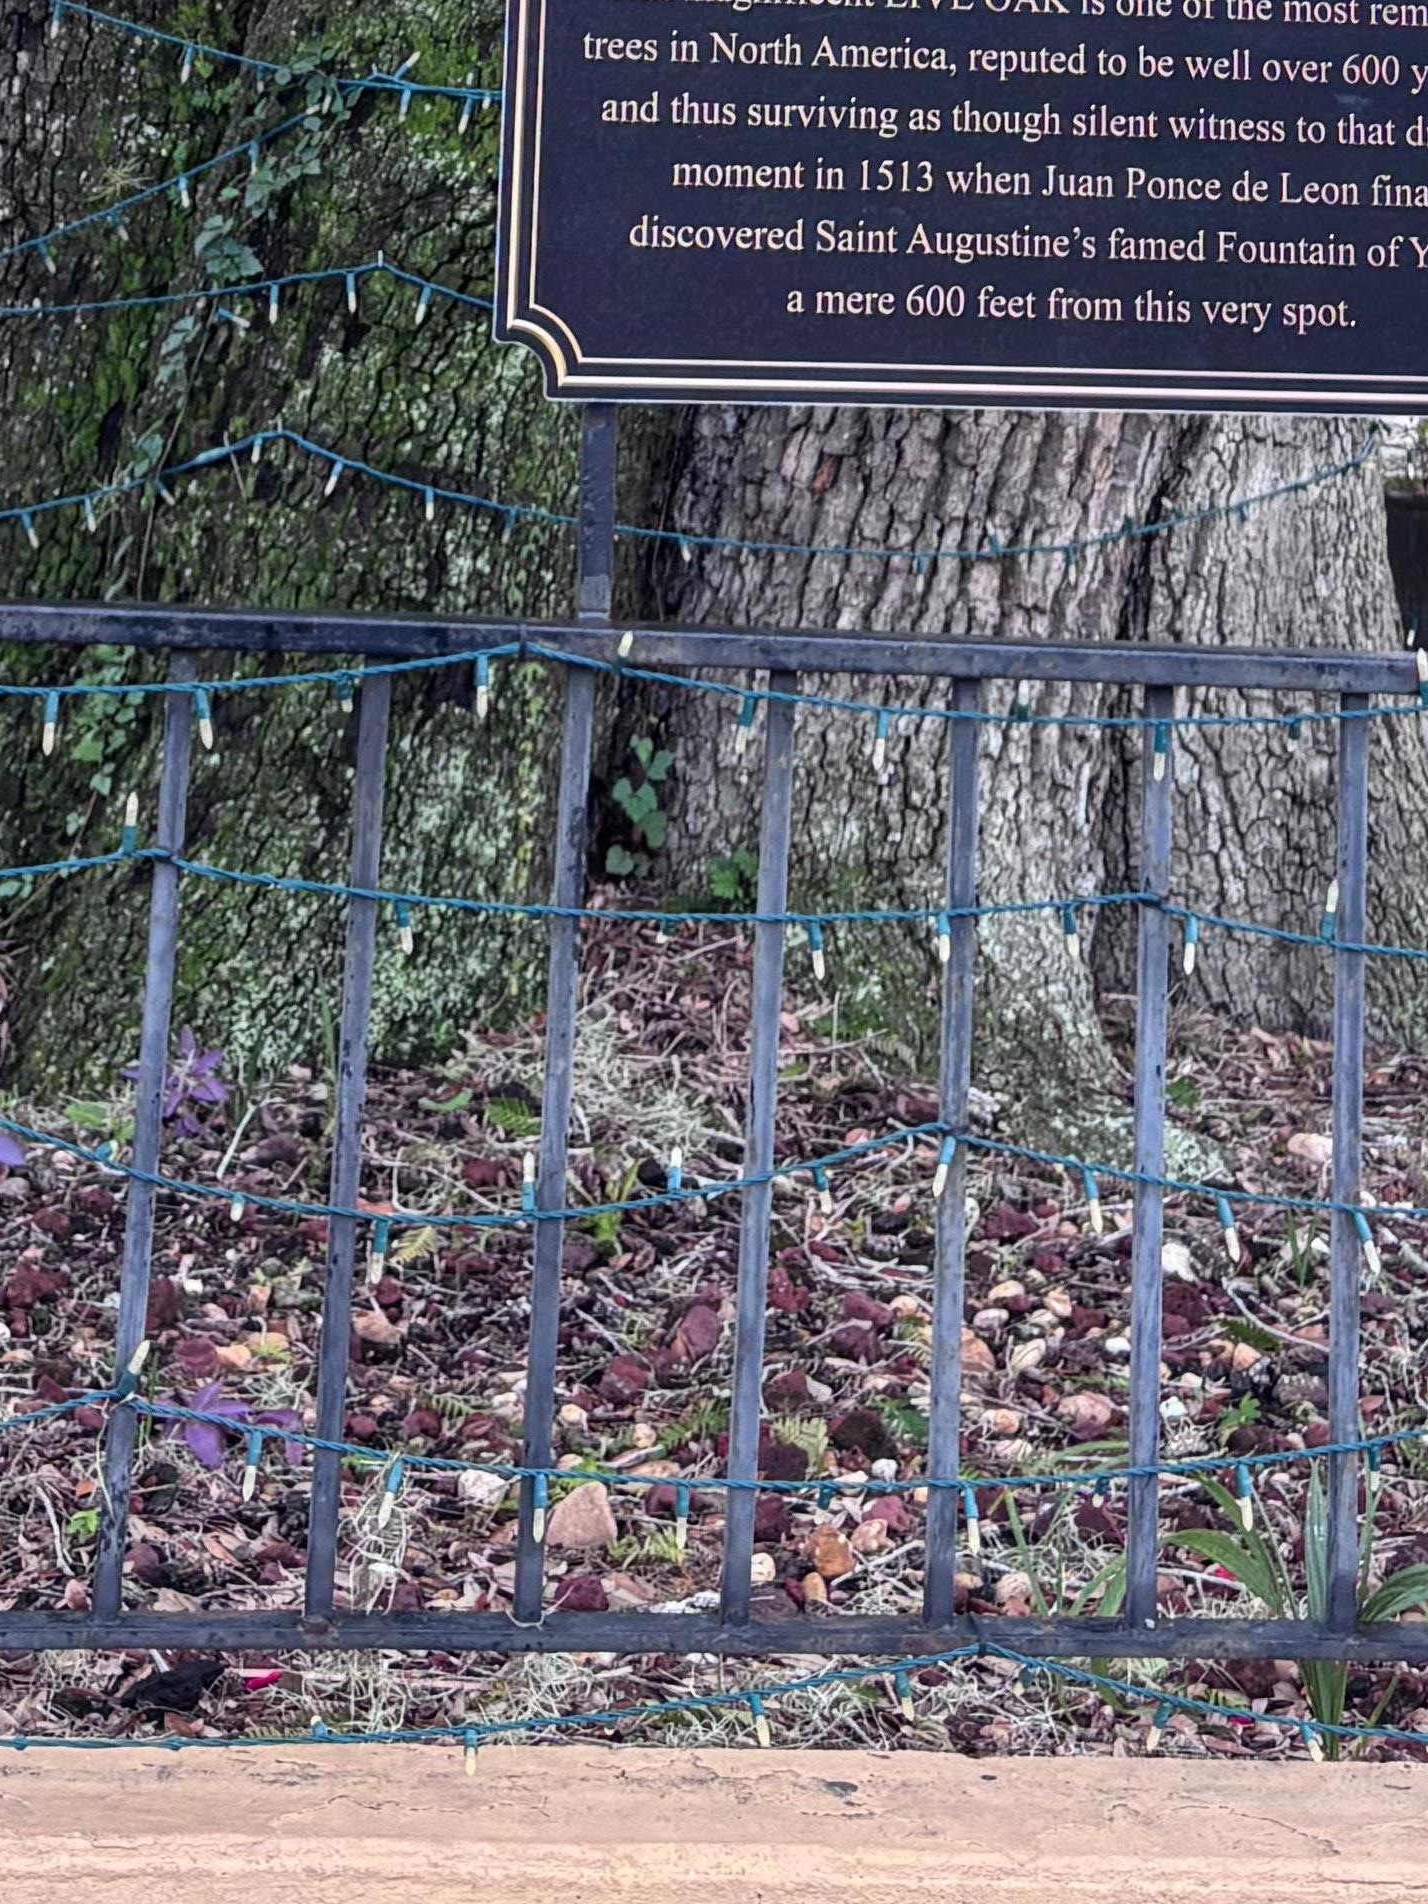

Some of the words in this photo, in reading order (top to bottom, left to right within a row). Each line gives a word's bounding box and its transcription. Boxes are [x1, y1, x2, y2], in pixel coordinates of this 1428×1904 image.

[583, 32, 658, 62] trees
[670, 29, 700, 63] in
[709, 31, 803, 66] North
[810, 35, 957, 77] America,
[968, 42, 1087, 82] reputed
[1097, 48, 1127, 77] to
[1138, 44, 1174, 78] be
[1184, 48, 1252, 81] well
[1262, 59, 1333, 84] over
[1342, 53, 1400, 86] 600
[601, 90, 660, 124] and
[670, 91, 737, 126] thus
[747, 95, 899, 139] surviving
[908, 108, 941, 132] as
[952, 99, 1062, 143] though
[1072, 103, 1159, 138] silent
[1168, 107, 1286, 143] witness
[1296, 116, 1326, 144] to
[1337, 112, 1396, 146] that
[672, 161, 805, 190] moment
[815, 156, 845, 191] in
[860, 159, 933, 193] 1513
[946, 161, 1032, 196] when
[1041, 164, 1114, 198] Juan
[1125, 167, 1222, 201] Ponce
[1231, 169, 1269, 202] de
[1280, 172, 1360, 206] Leon
[629, 214, 805, 251] discovered
[816, 219, 898, 254] Saint
[1107, 227, 1206, 262] famed
[1216, 230, 1357, 267] Fountain
[1366, 235, 1405, 268] of
[786, 290, 805, 313] a
[815, 291, 896, 315] mere
[905, 284, 965, 317] 600
[977, 285, 1037, 319] feet
[1047, 286, 1124, 322] from
[1134, 289, 1191, 323] this
[1201, 300, 1272, 334] very
[1282, 300, 1356, 335] spot.
